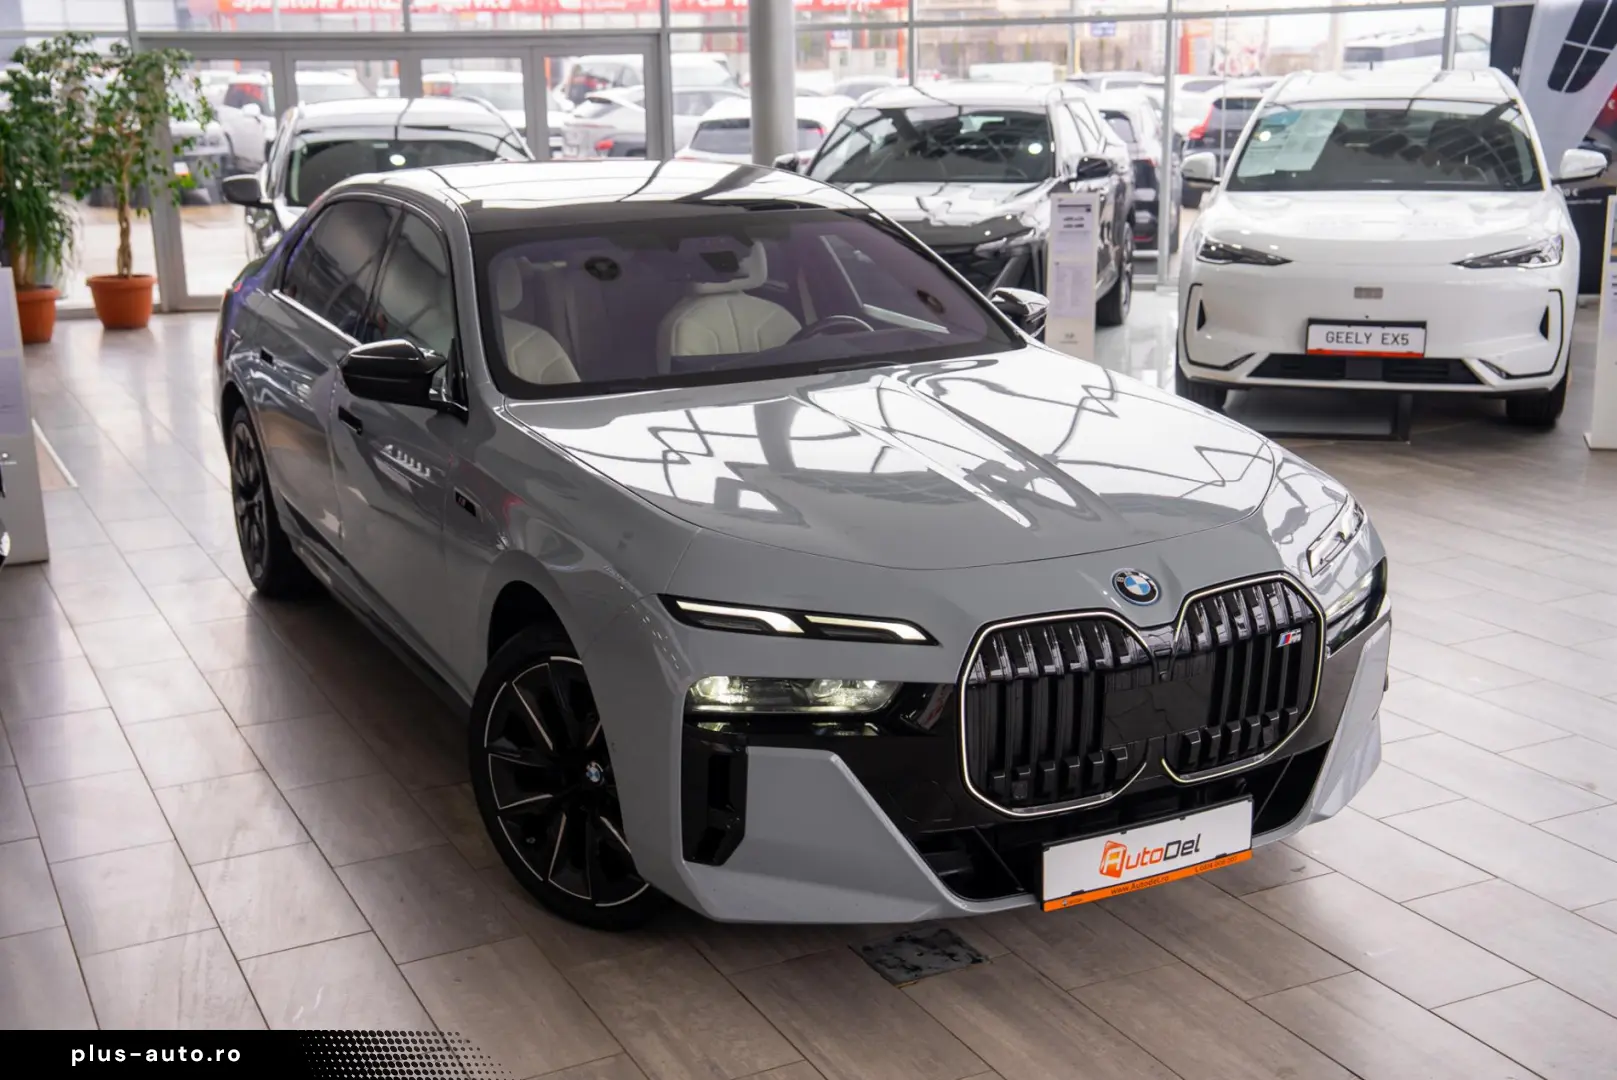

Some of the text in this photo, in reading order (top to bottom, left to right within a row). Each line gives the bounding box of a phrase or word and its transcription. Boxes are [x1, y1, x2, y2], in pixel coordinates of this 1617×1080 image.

[1325, 331, 1410, 346] GEELY EX5
[1100, 833, 1202, 878] AutoDel
